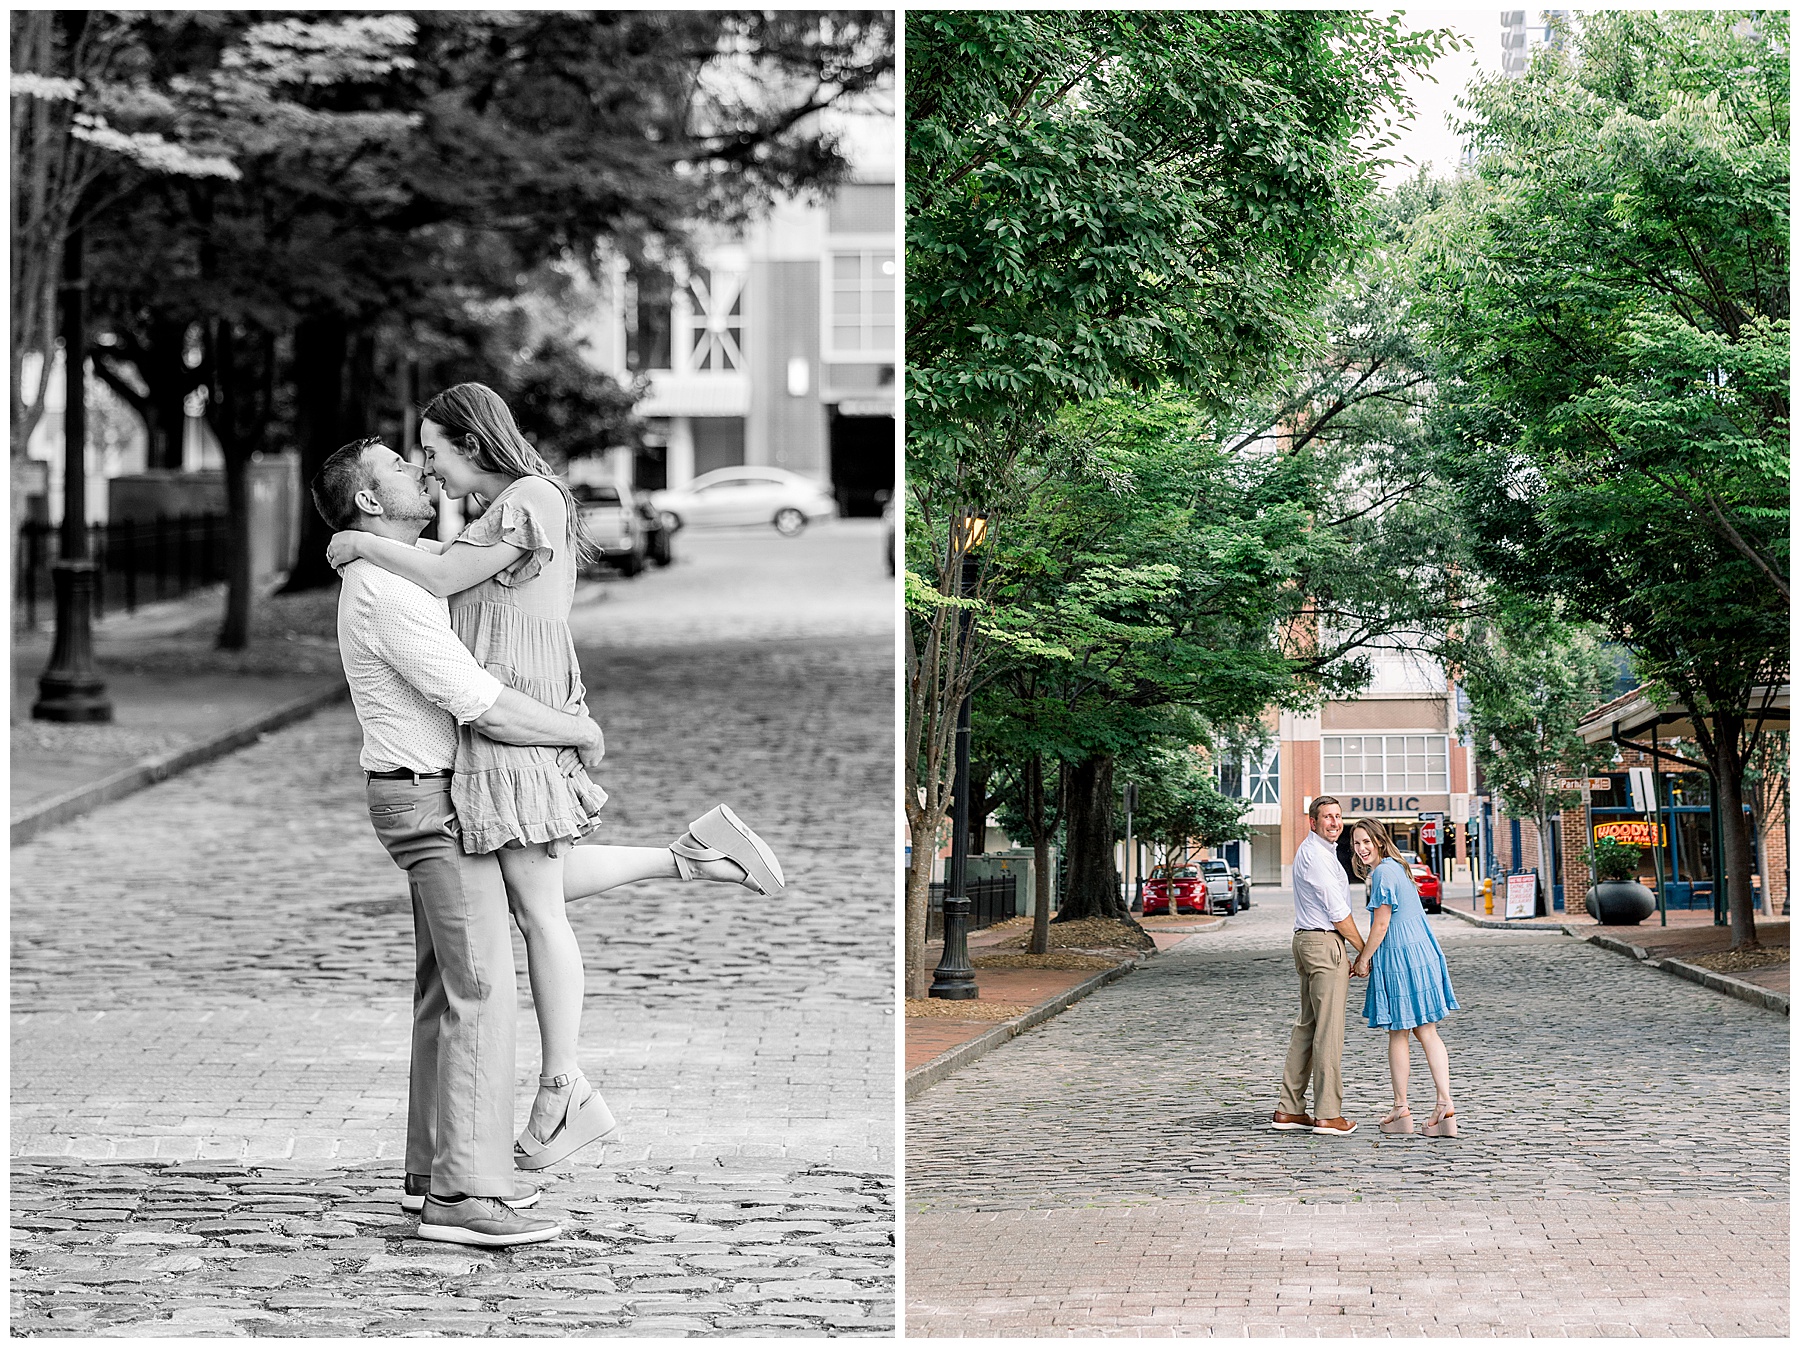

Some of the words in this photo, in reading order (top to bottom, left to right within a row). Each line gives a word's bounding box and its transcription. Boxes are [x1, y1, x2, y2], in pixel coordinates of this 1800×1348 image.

[1561, 779, 1590, 789] Parh
[1351, 797, 1419, 811] PUBLIC
[1422, 829, 1437, 838] STO
[1598, 824, 1658, 838] WOODYS
